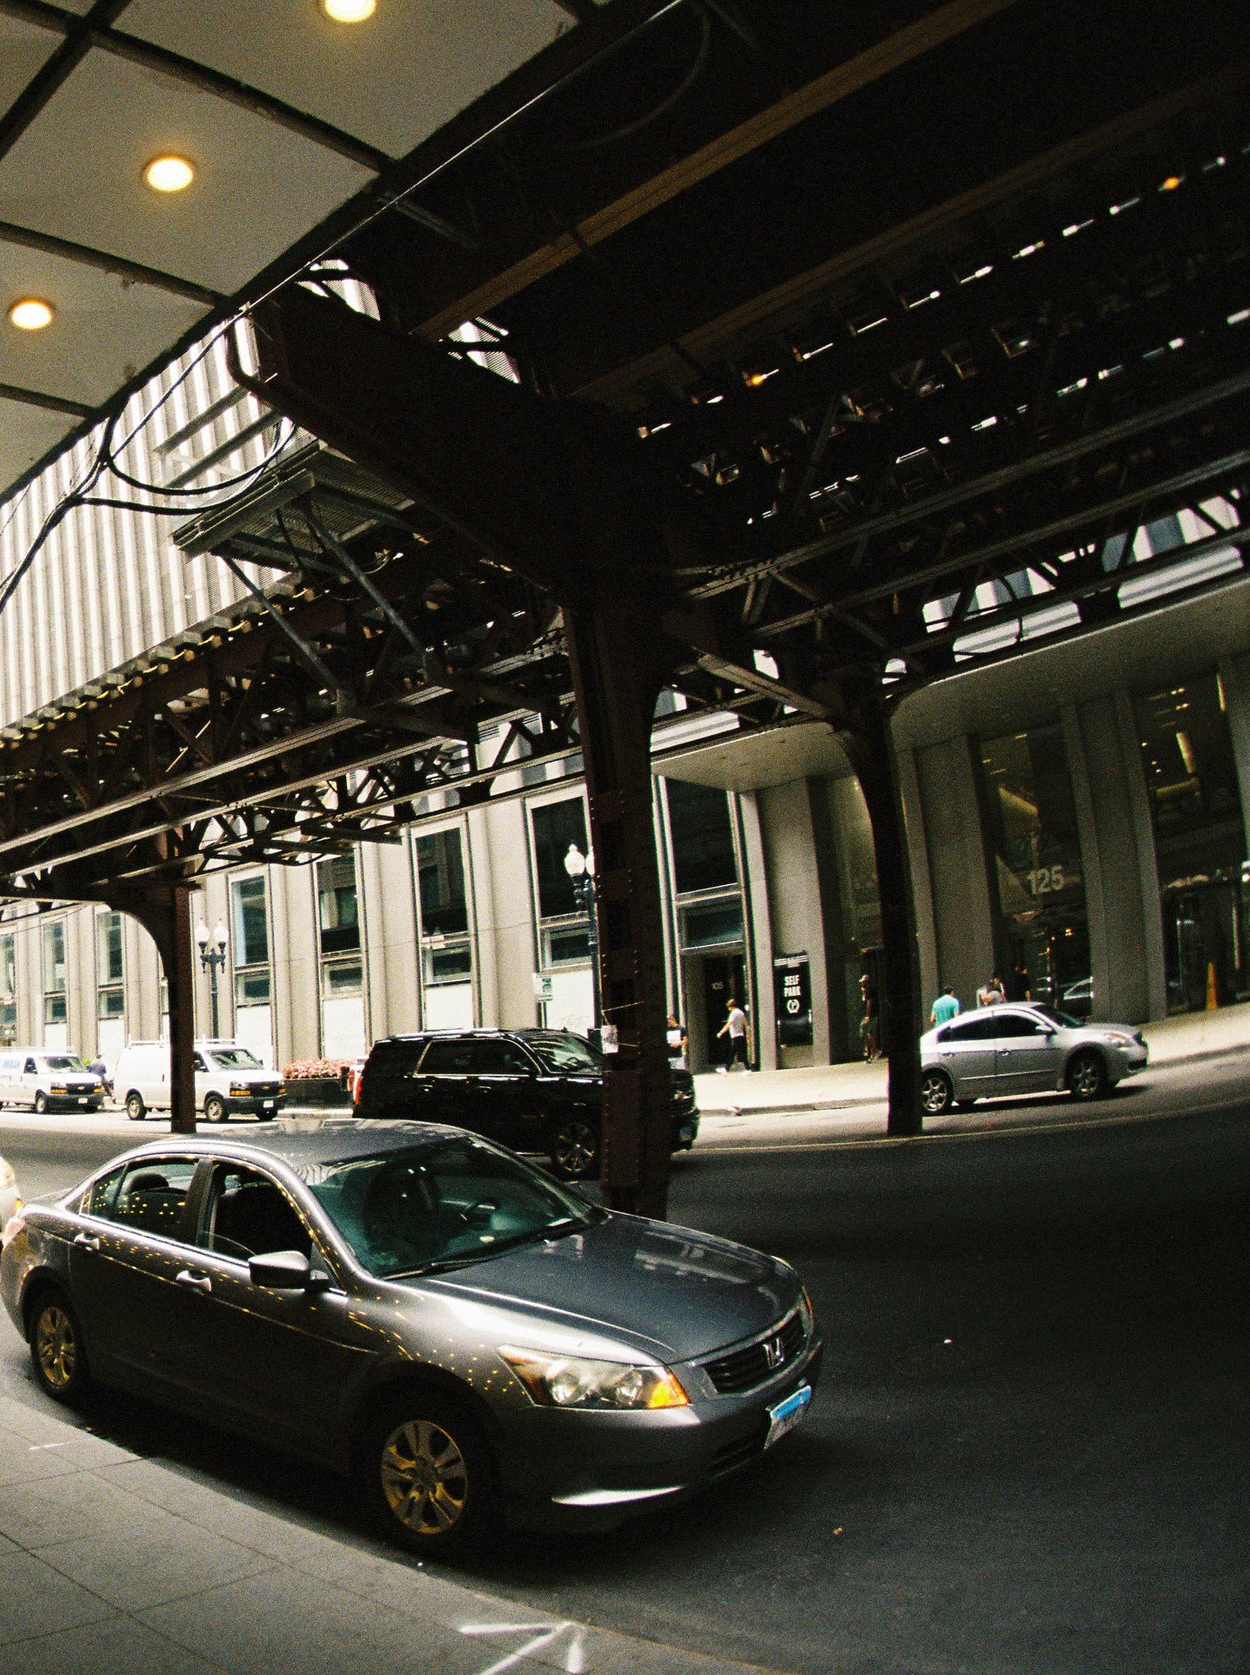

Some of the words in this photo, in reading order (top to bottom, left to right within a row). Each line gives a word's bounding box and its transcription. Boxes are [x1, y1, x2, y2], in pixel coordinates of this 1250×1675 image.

[1026, 865, 1065, 896] 125
[784, 975, 800, 986] SELF
[784, 986, 801, 998] PARK
